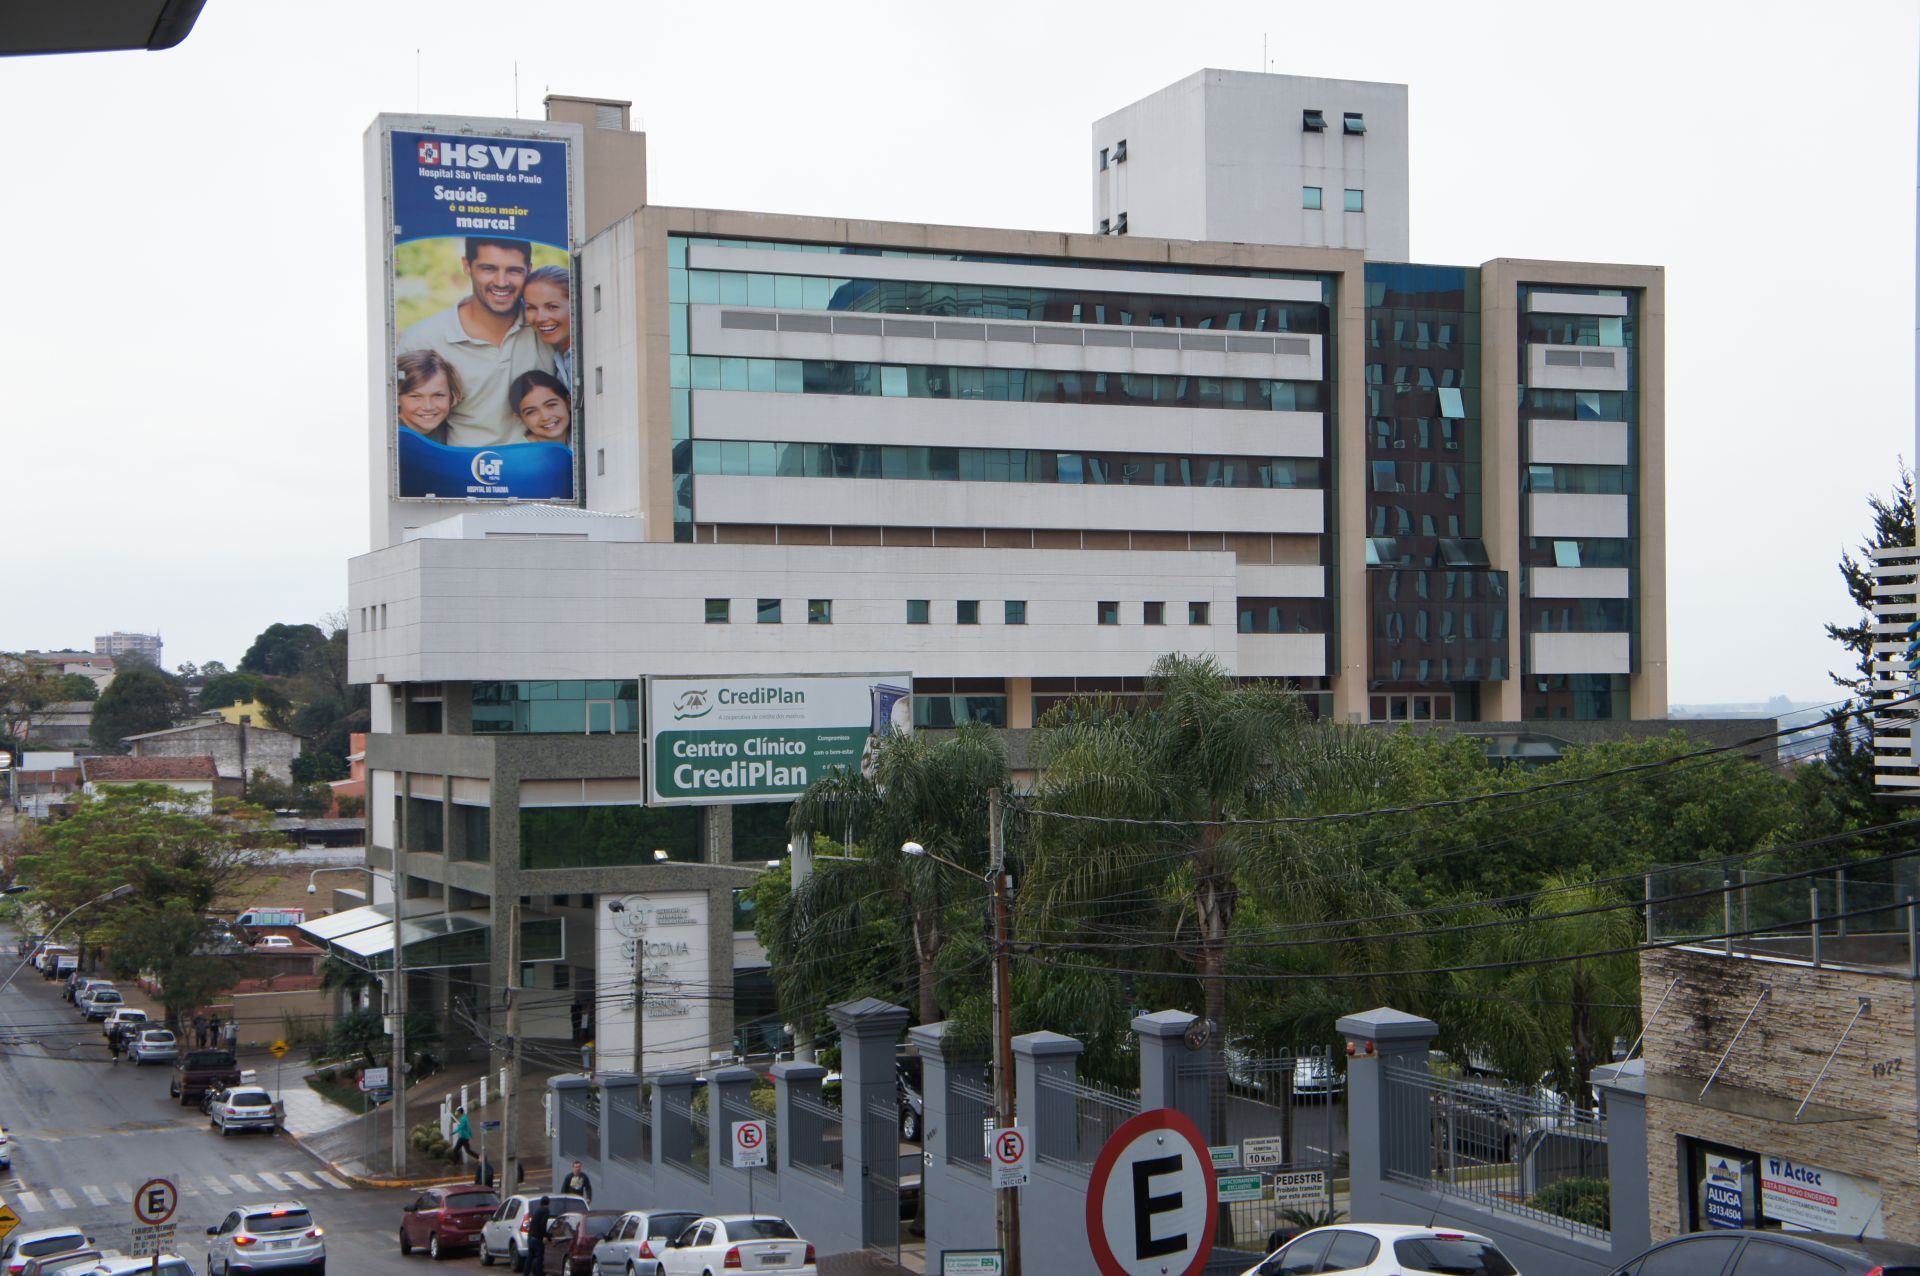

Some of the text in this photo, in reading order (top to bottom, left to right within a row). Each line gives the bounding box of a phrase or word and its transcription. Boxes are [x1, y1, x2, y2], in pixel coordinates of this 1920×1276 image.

[440, 142, 541, 171] HSVP
[418, 167, 542, 184] Hospital São Vicente de Paulo
[434, 185, 487, 202] Saúde
[449, 203, 529, 216] é a nossa maior
[456, 216, 516, 230] marca!
[718, 687, 805, 705] CrediPlan
[673, 737, 806, 757] Centro Clínico
[673, 760, 807, 789] CrediPlan
[1004, 1138, 1016, 1156] E
[1249, 1154, 1260, 1163] 10
[1276, 1173, 1322, 1186] PEDESTRE
[1784, 1161, 1821, 1186] Actec
[1300, 1184, 1322, 1192] transitar
[1708, 1187, 1741, 1207] ALUGA
[1787, 1186, 1803, 1197] NOVO
[147, 1189, 165, 1213] E
[1132, 1153, 1187, 1260] E
[1707, 1203, 1741, 1221] 3313.4504
